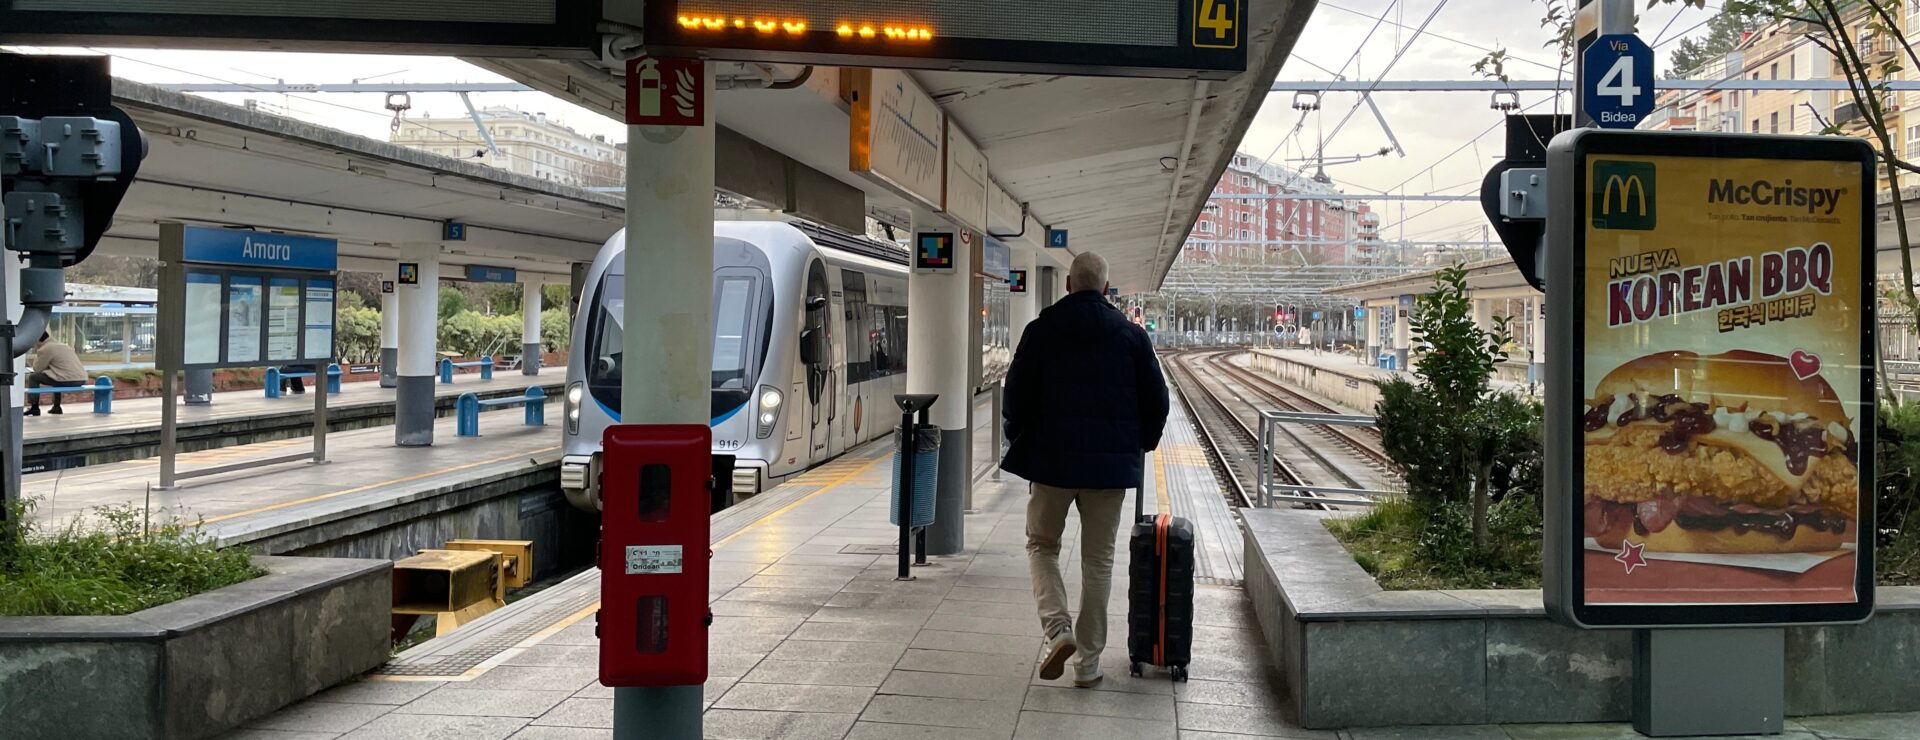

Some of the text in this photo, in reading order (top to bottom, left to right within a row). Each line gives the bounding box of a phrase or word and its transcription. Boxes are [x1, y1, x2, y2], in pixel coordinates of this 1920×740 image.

[1199, 0, 1233, 39] 4
[1597, 55, 1642, 107] 4
[1601, 111, 1636, 122] Bidea
[452, 226, 459, 238] 5
[1054, 233, 1062, 245] 4
[242, 236, 291, 261] Amara
[1609, 248, 1680, 278] NUEVA
[1608, 243, 1832, 328] KOREAN BBQ
[1718, 294, 1816, 333] 한국식 바비큐
[719, 439, 739, 449] 916
